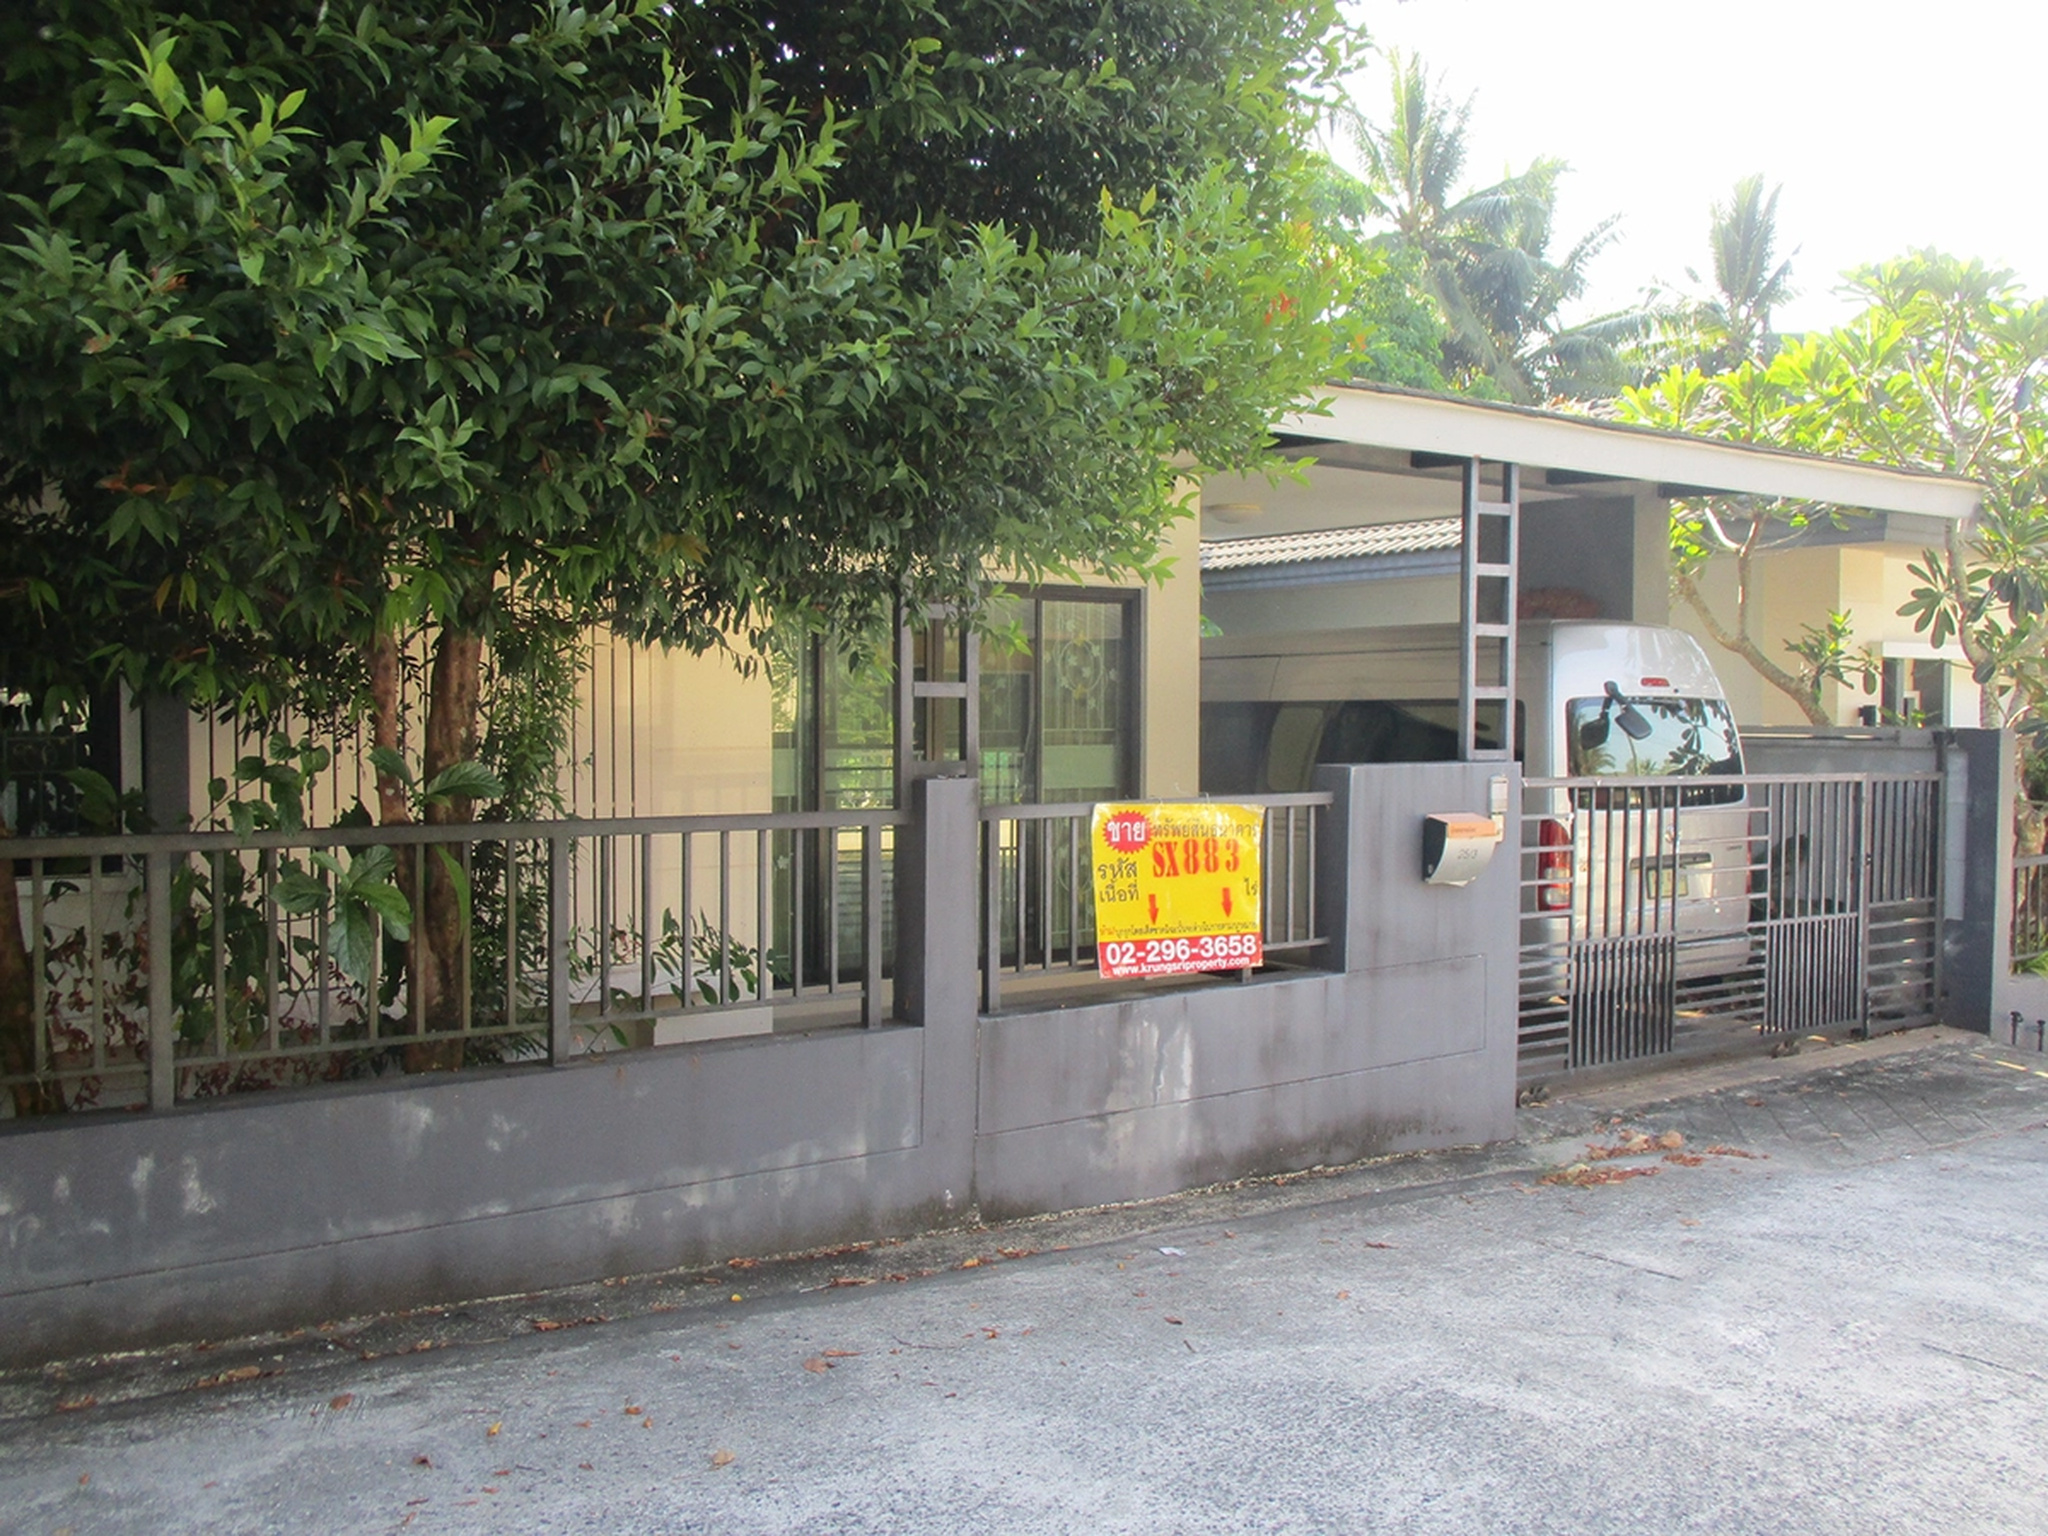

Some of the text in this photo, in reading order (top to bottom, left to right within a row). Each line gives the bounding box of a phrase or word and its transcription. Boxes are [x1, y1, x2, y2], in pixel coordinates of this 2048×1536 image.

[1106, 820, 1147, 843] ขาย
[1097, 858, 1138, 880] รหัส
[1152, 838, 1240, 878] SX883
[1099, 879, 1140, 903] เนื้อที่
[1106, 935, 1257, 966] 02-296-3658
[1112, 957, 1250, 976] www.krungsriproperty.com
